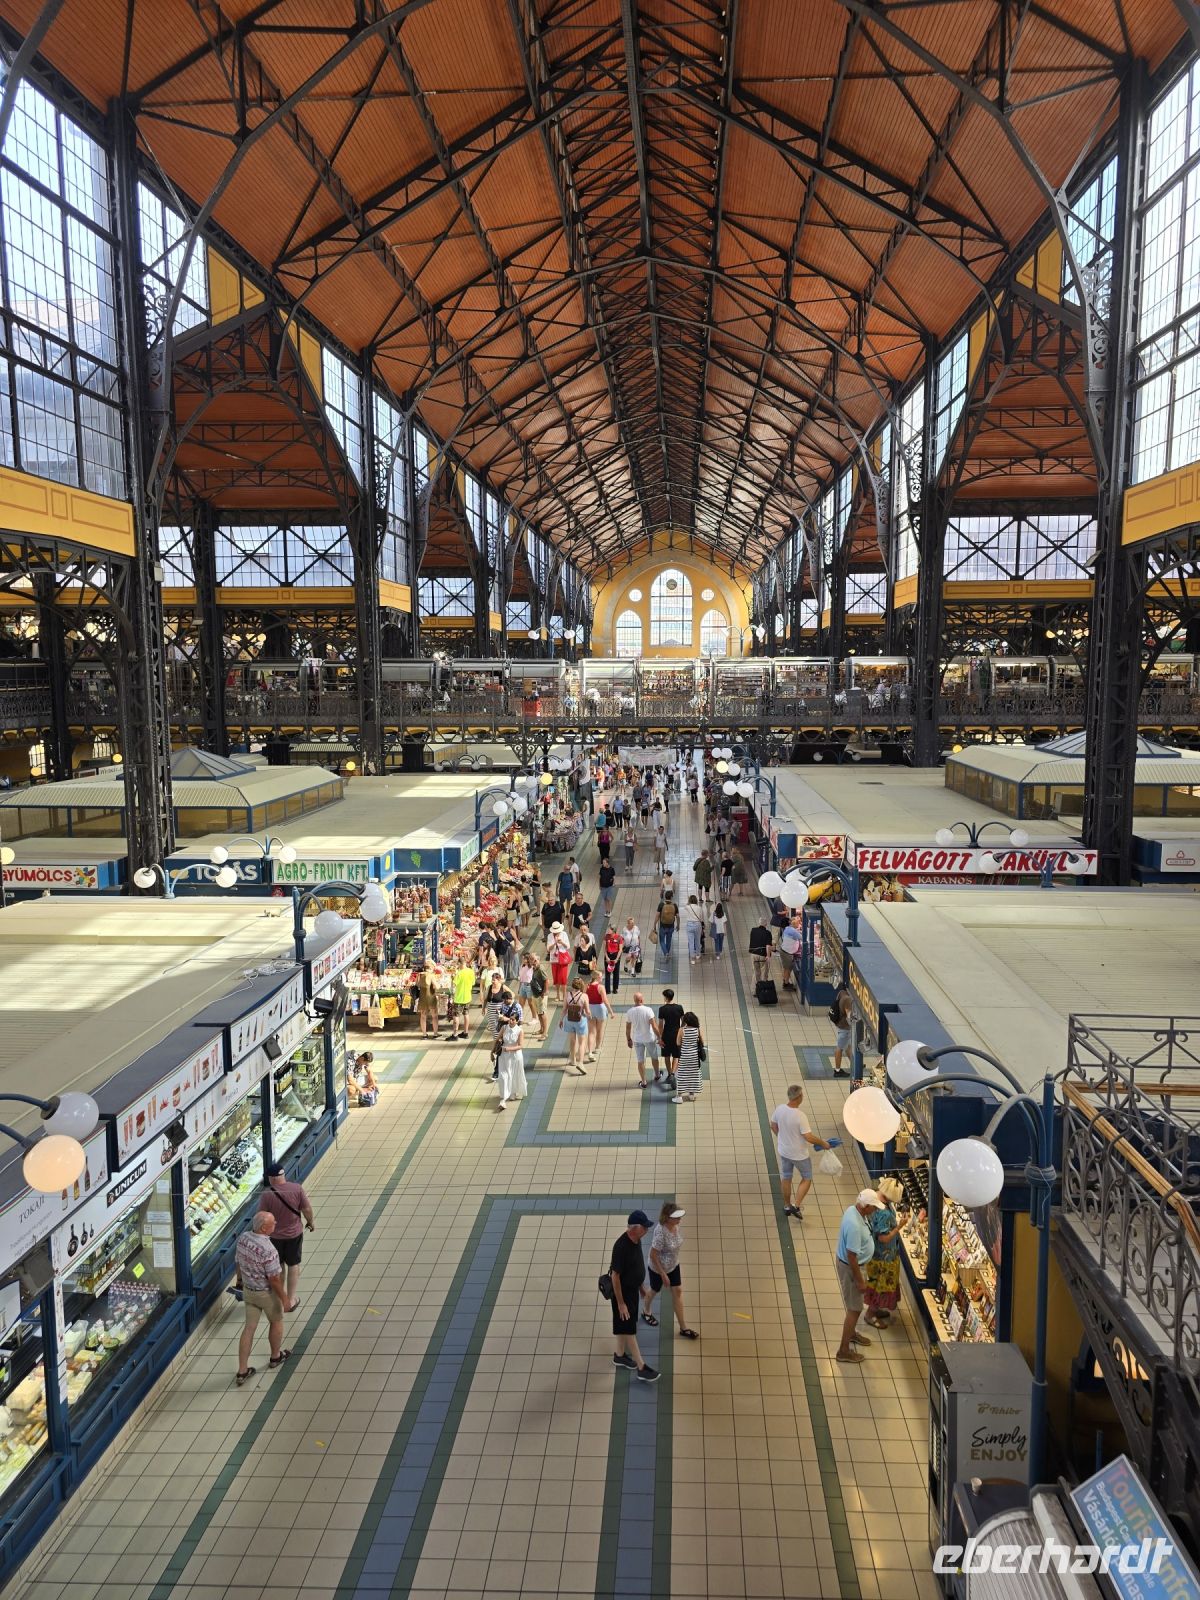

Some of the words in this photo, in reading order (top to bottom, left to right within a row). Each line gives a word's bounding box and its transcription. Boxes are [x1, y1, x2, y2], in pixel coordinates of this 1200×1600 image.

[195, 861, 258, 881] TOÁS
[277, 862, 345, 881] AGRO-FRUIT
[858, 848, 972, 872] FELVÁGOTT
[114, 1161, 147, 1197] UNICUM
[971, 1425, 1027, 1453] Simply
[970, 1448, 1028, 1462] ENJOY
[1096, 1481, 1123, 1527] Budapest
